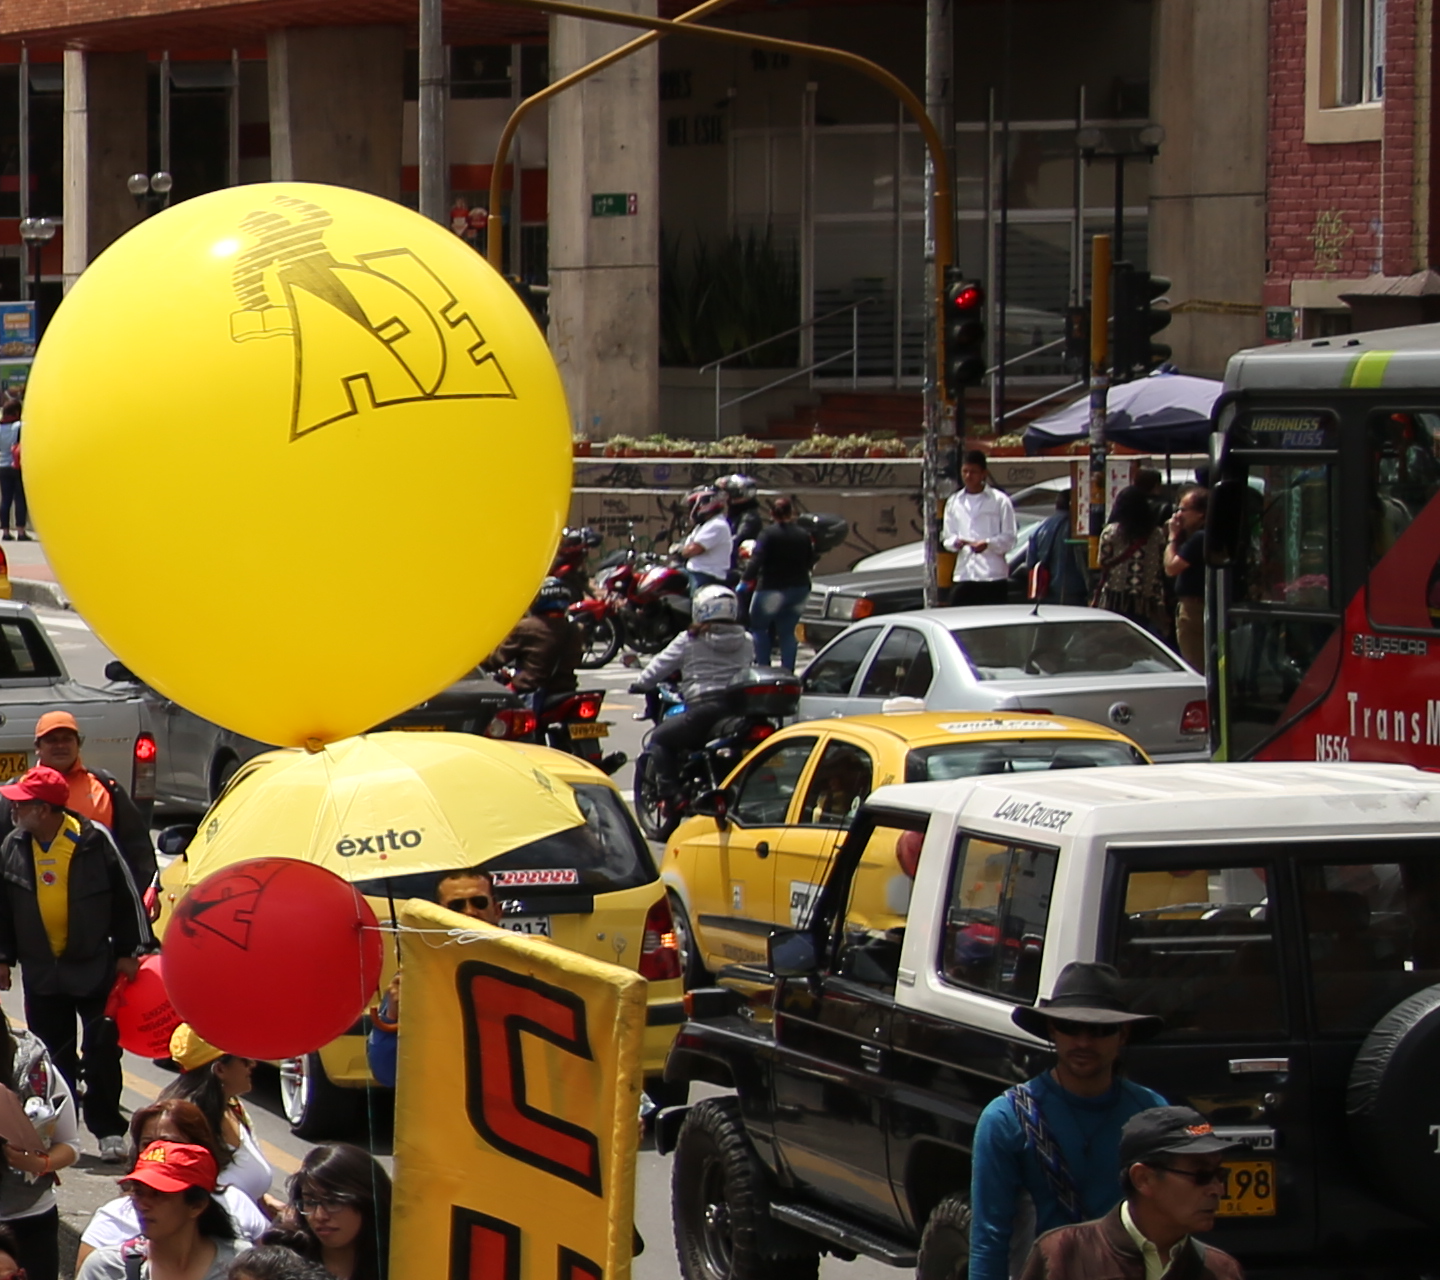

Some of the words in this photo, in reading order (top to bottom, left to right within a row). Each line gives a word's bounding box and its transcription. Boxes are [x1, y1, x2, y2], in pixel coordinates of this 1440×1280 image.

[1315, 732, 1350, 762] N556
[993, 795, 1030, 823] LAND
[335, 828, 423, 860] éxito
